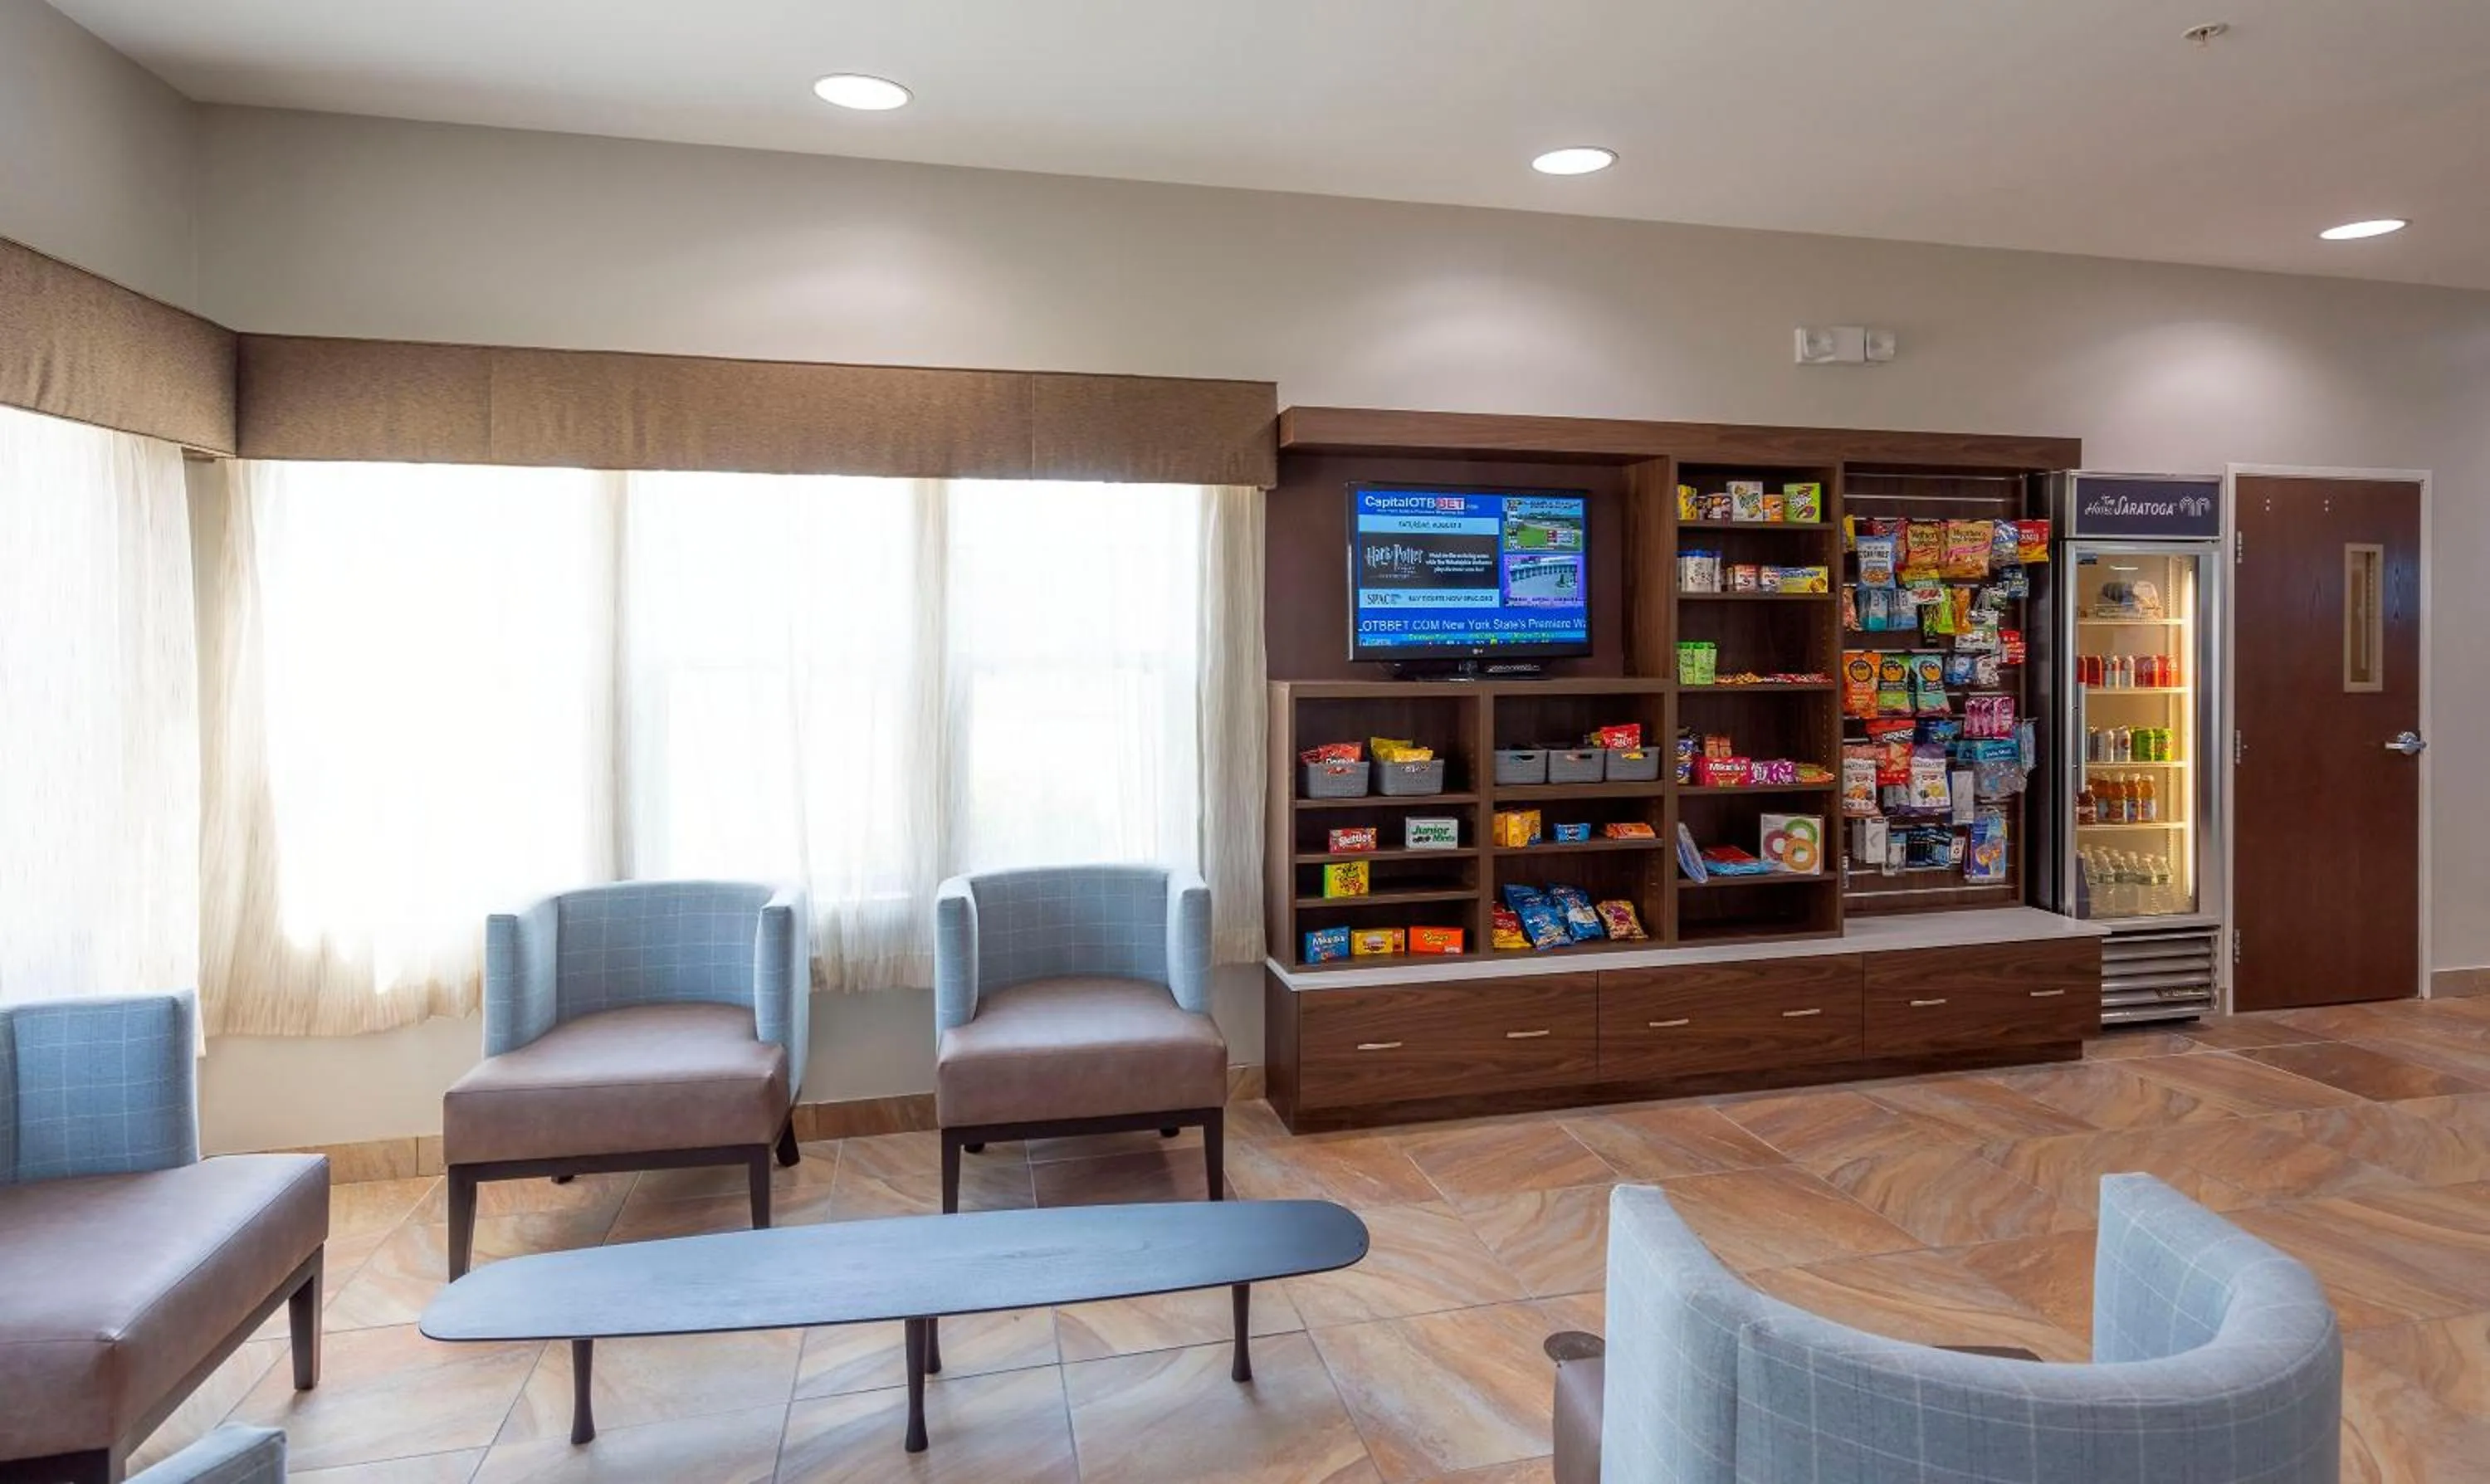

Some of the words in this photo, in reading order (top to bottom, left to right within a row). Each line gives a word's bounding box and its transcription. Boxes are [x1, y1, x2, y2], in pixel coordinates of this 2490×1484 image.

[1443, 620, 1465, 630] New
[1467, 619, 1491, 630] York
[1493, 618, 1526, 630] State's
[1411, 825, 1450, 836] Junior
